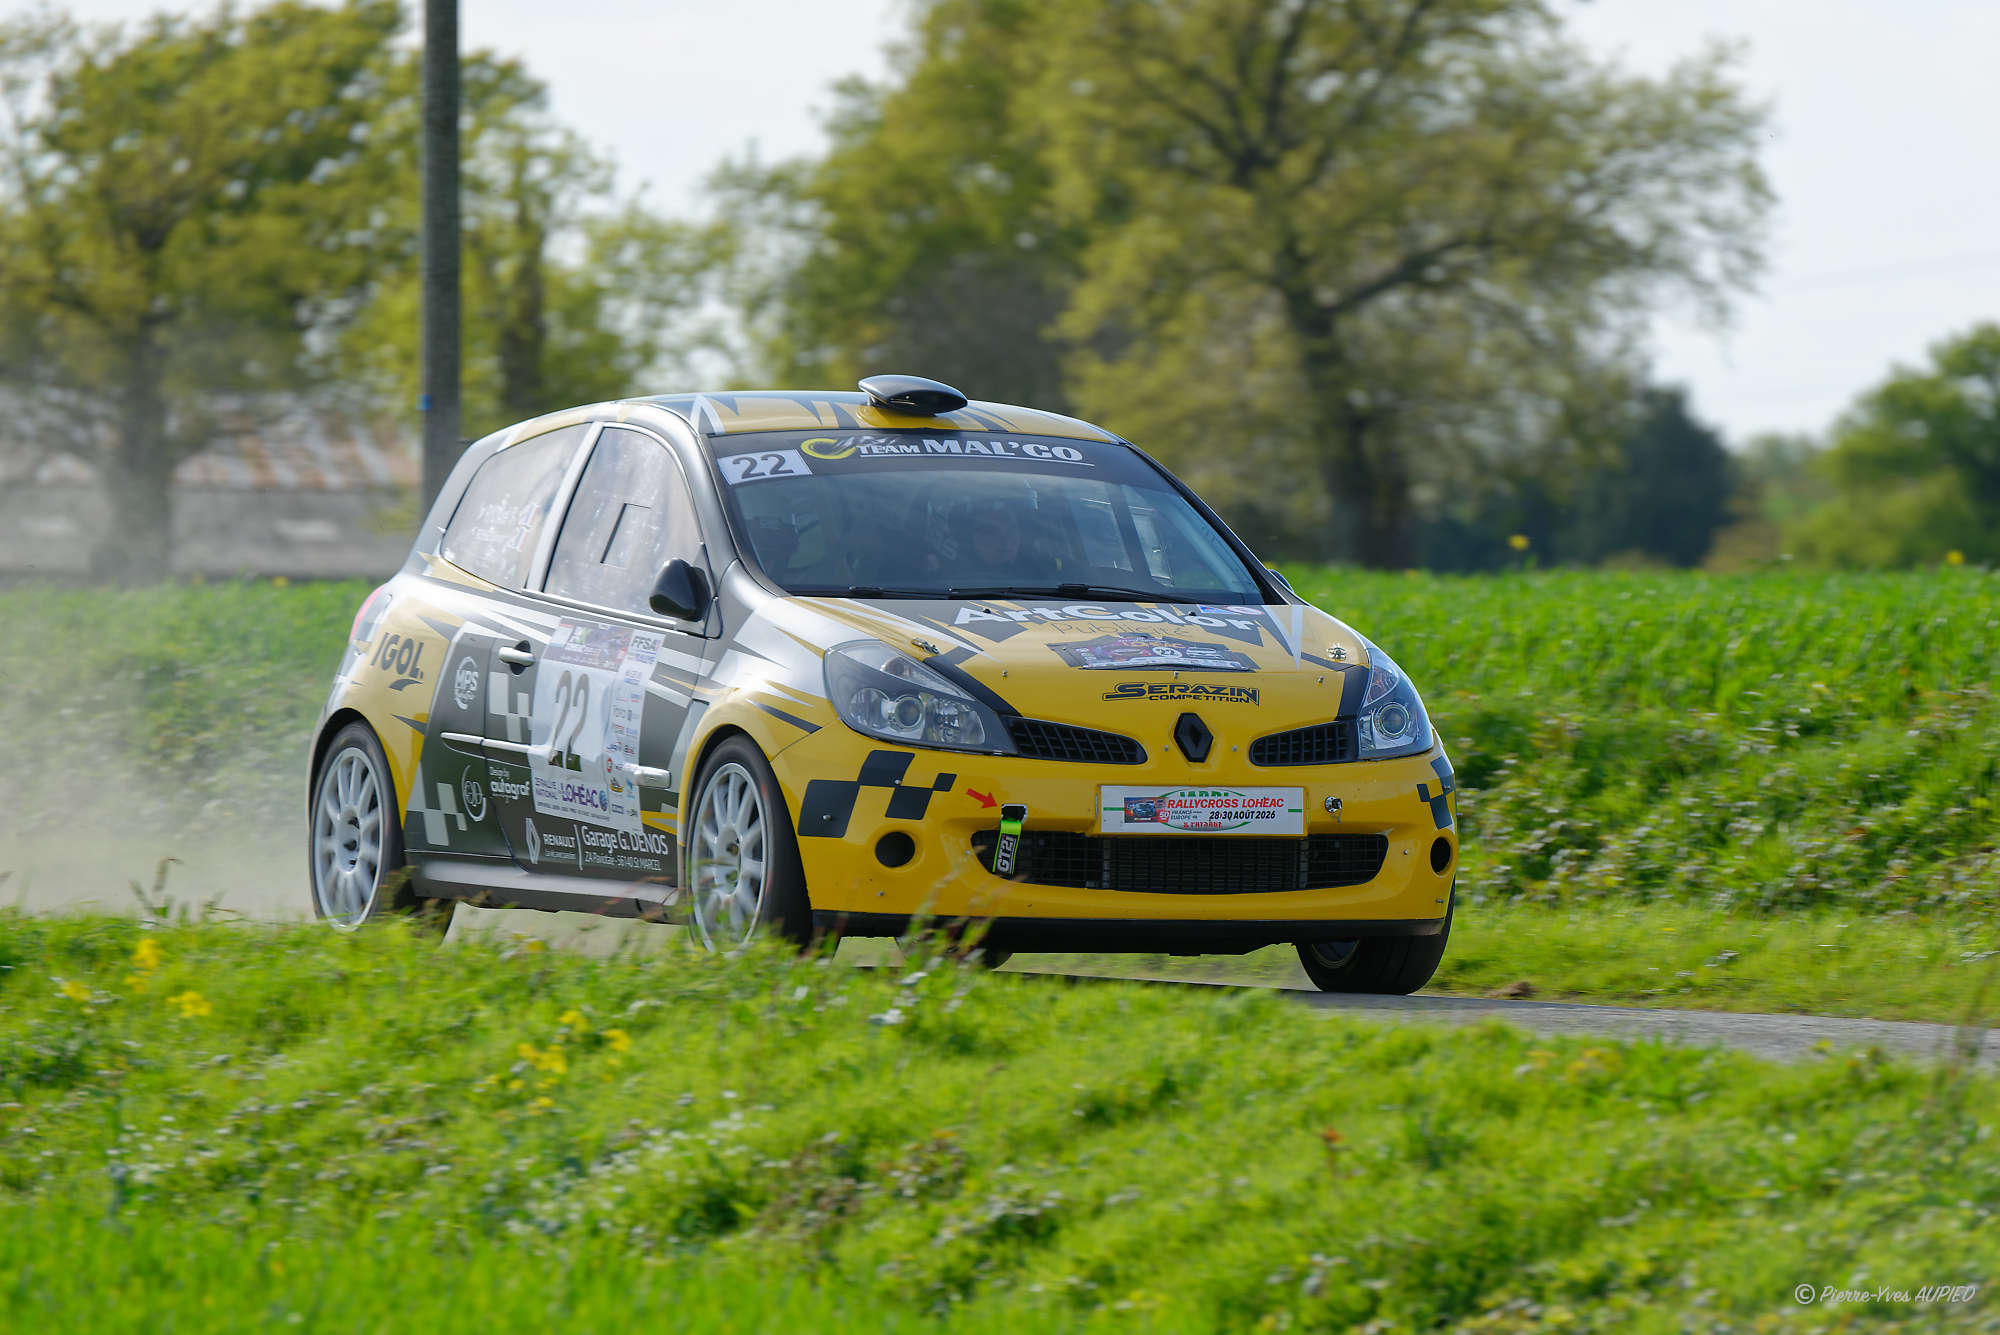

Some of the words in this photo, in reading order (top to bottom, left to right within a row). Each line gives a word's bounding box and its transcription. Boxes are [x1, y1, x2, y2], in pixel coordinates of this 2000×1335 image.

[856, 444, 920, 454] TEAM
[732, 453, 795, 479] 22
[954, 605, 1256, 631] ArtColor
[631, 635, 657, 651] FFSA
[1103, 681, 1260, 705] SERAZIN
[1149, 694, 1252, 704] COMPETITION
[548, 670, 590, 771] 22
[490, 779, 530, 800] autograf
[559, 783, 599, 809] LOHÉAC
[1167, 798, 1239, 809] RALLYCROSS
[1242, 796, 1285, 808] LOHÉAC
[1233, 809, 1255, 820] AOÛT
[1255, 810, 1276, 820] 2026
[543, 833, 576, 848] RENAULT
[581, 826, 618, 853] Garage
[617, 830, 631, 851] G.
[630, 832, 669, 855] DENOS
